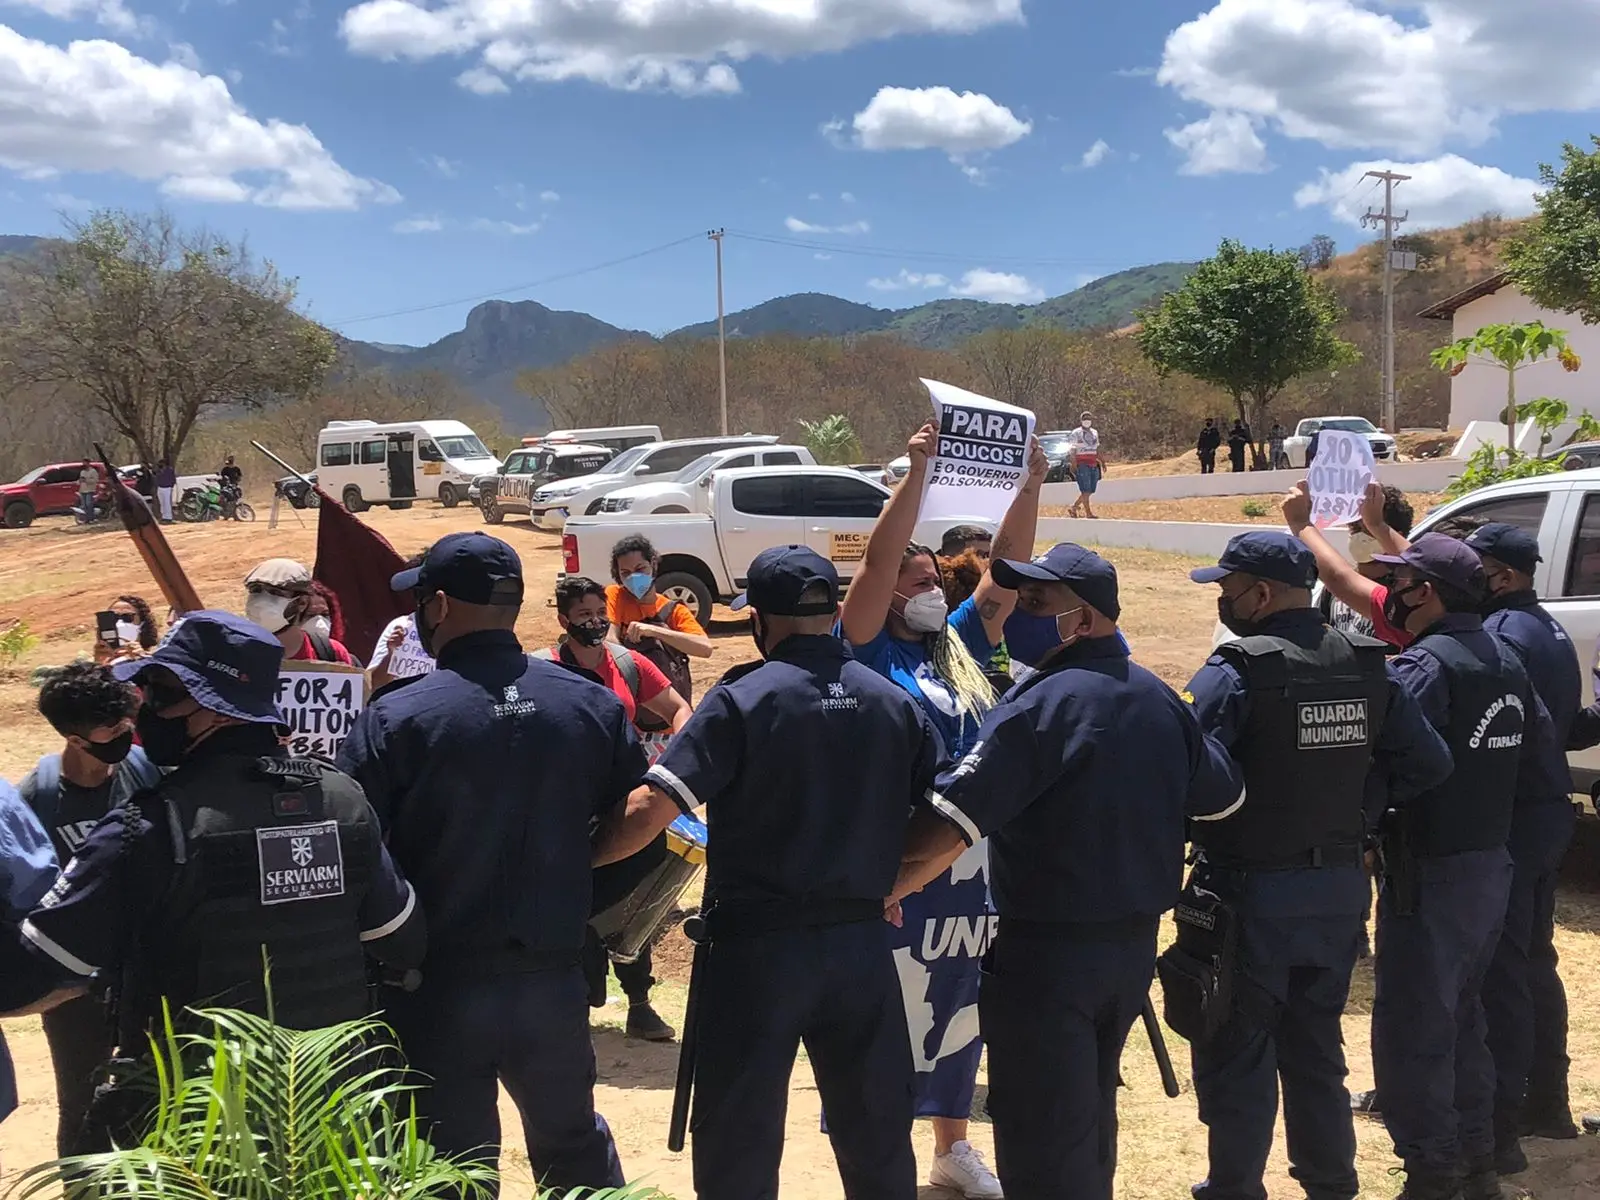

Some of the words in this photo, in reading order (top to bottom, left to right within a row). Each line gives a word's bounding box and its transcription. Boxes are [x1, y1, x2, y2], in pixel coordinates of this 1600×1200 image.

[934, 460, 943, 473] É
[944, 463, 954, 473] O
[957, 465, 1020, 480] GOVERNO
[929, 476, 1014, 491] BOLSONARO
[834, 534, 860, 542] MEC
[206, 660, 240, 678] RAFAEL
[1301, 703, 1366, 724] GUARDA
[1469, 697, 1505, 748] GUARDA
[1301, 725, 1366, 744] MUNICIPAL
[266, 864, 339, 887] SERVIARM
[266, 880, 340, 896] SEGURANÇA
